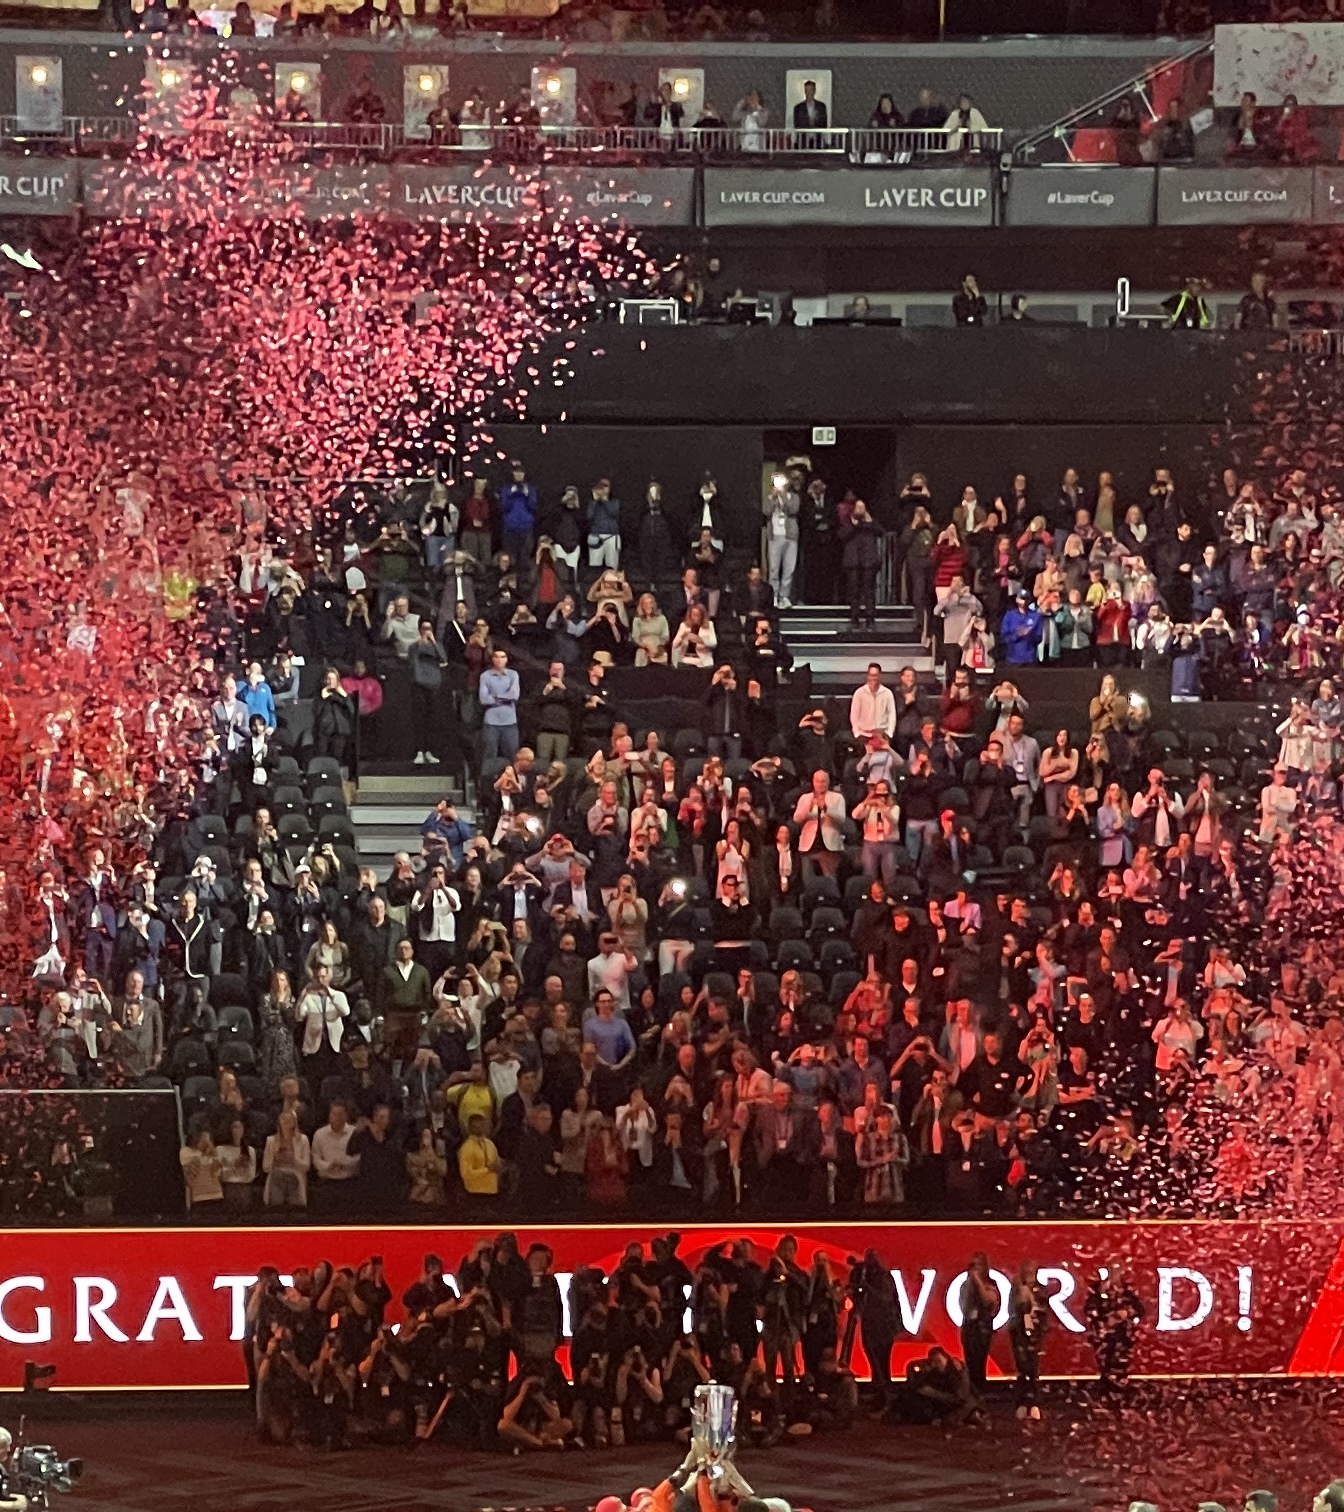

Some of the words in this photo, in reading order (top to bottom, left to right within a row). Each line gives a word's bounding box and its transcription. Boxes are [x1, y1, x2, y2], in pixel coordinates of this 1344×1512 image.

[16, 176, 64, 196] CUP
[405, 185, 472, 204] LAVER
[721, 191, 760, 204] LAVER
[864, 188, 936, 207] LAVER
[939, 188, 988, 207] CUP
[1047, 190, 1115, 206] #LaverCup
[1182, 190, 1222, 202] LAVER
